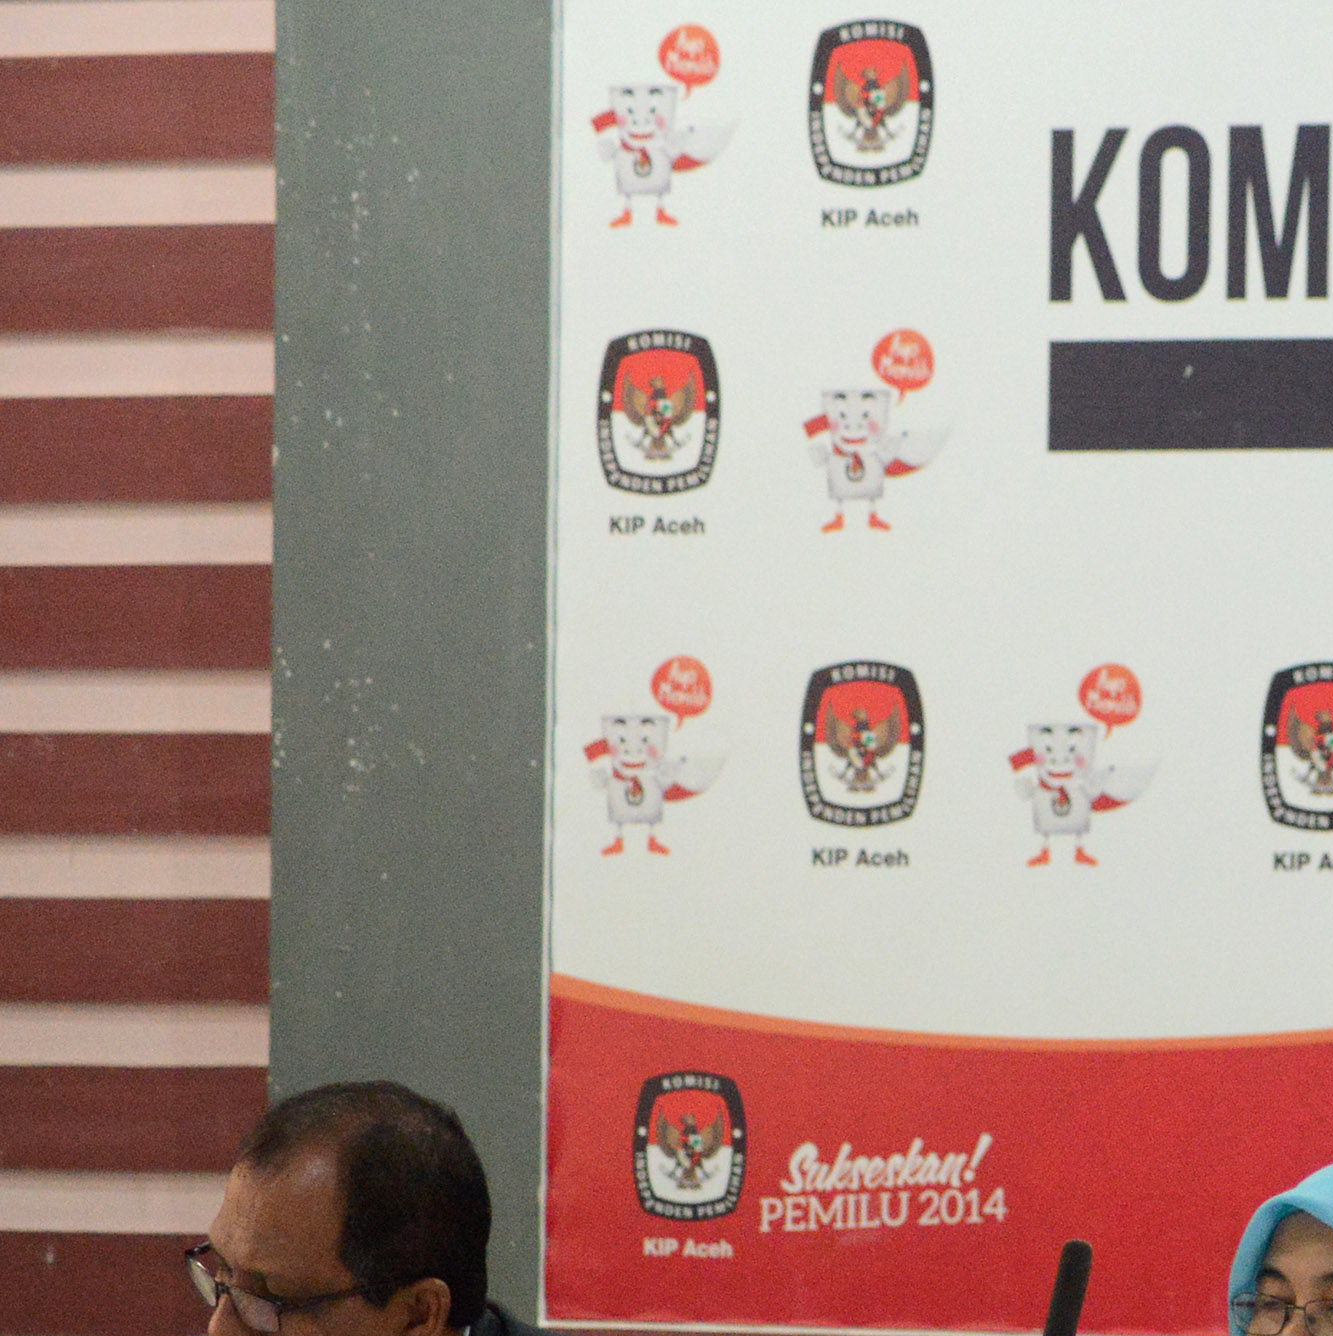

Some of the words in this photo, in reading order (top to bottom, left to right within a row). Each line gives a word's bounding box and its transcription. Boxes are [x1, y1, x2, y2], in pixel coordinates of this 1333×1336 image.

[821, 209, 858, 227] KIP
[865, 209, 919, 226] Aceh
[609, 516, 645, 533] KIP
[653, 517, 705, 534] Aceh
[812, 848, 848, 866] KIP
[856, 849, 909, 866] Aceh
[1273, 852, 1311, 870] KIP
[781, 1132, 993, 1193] Sukseskan!
[760, 1192, 908, 1232] PEMILU
[918, 1187, 1007, 1226] 2014
[642, 1236, 679, 1258] KIP
[682, 1236, 734, 1260] Aceh
